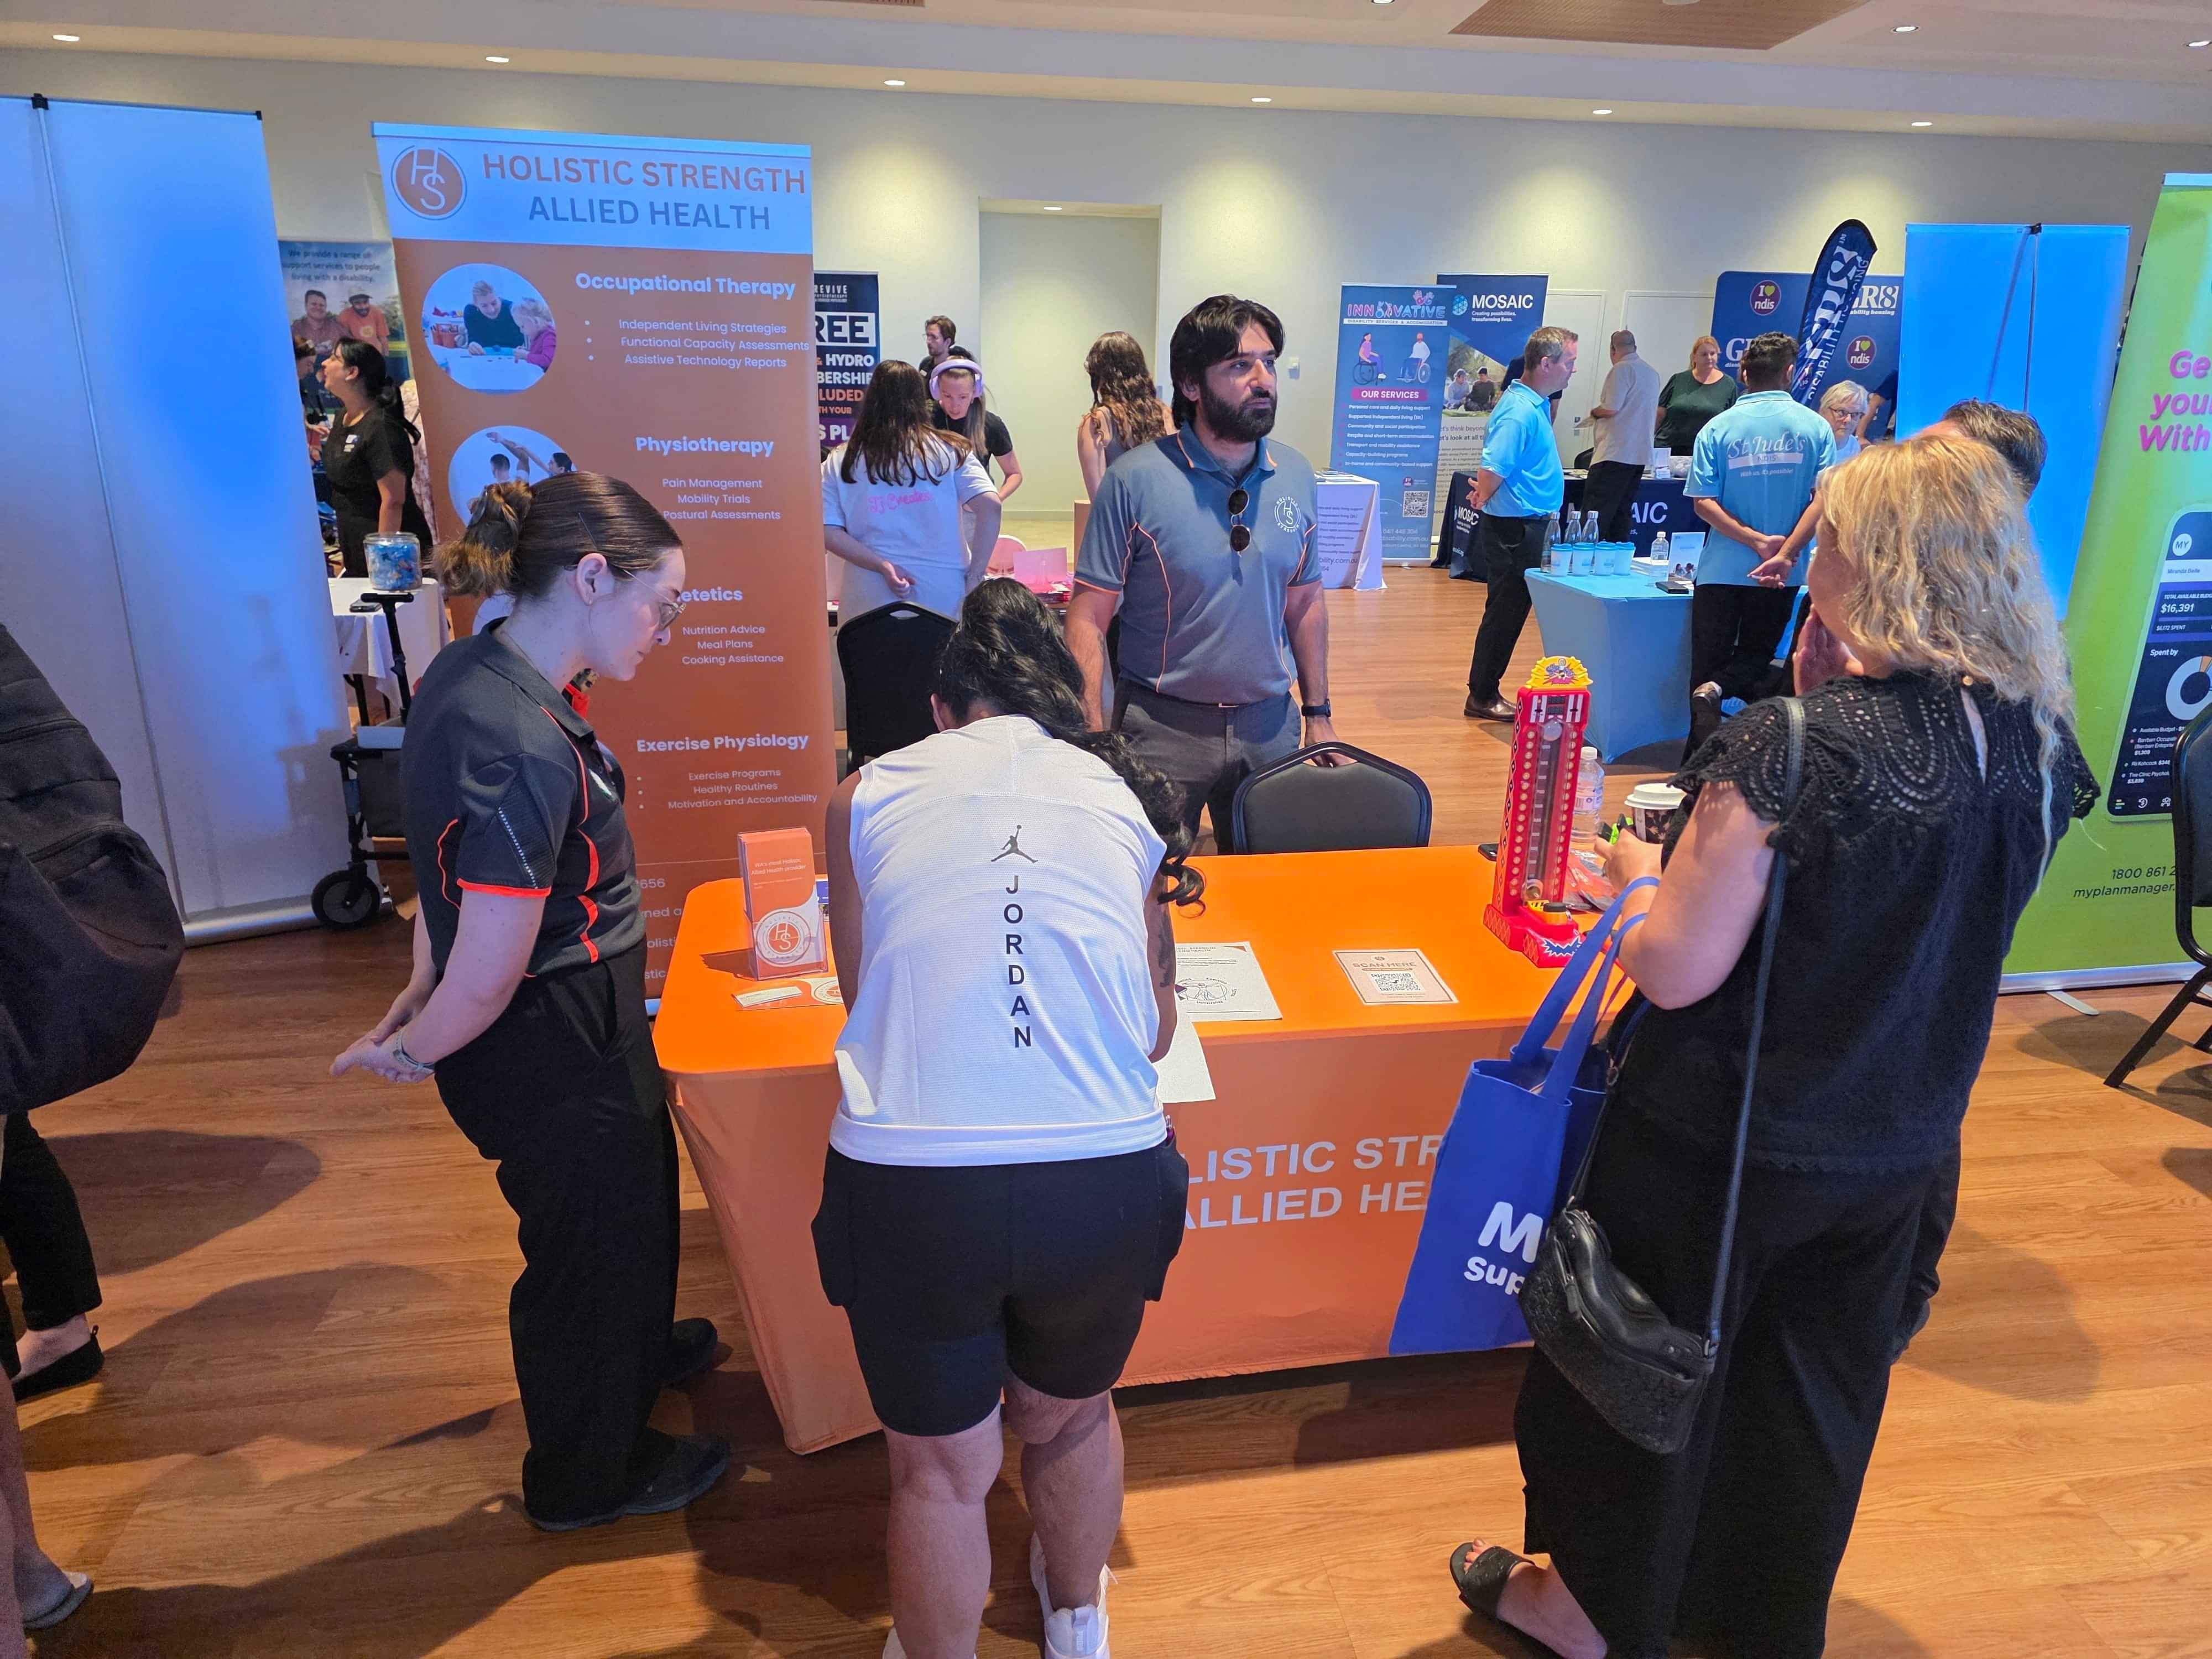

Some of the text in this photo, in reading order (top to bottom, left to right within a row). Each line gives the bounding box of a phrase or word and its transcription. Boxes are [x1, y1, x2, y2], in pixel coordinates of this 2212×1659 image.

[482, 153, 806, 194] HOLISTIC STRENGTH
[528, 195, 770, 230] ALLIED HEALTH
[575, 272, 796, 300] Occupational Therapy
[814, 284, 848, 294] REVIVE
[1472, 294, 1533, 309] MOSAIC
[1754, 299, 1775, 310] ndis
[618, 318, 787, 336] Independent Living Strategies
[815, 315, 869, 343] REE
[620, 336, 810, 352] Functional Capacity Assessments
[624, 354, 787, 369] Assistive Technology Reports
[826, 354, 875, 367] HYDRO
[1850, 353, 1870, 364] ndis
[2169, 350, 2211, 379] Ge
[817, 371, 873, 385] BERSHIP
[819, 389, 864, 401] LUDED
[1361, 390, 1420, 399] OUR SERVICES
[2150, 393, 2212, 420] you
[1749, 431, 1806, 454] Jude's
[2139, 423, 2210, 452] With
[636, 436, 774, 457] Physiotherapy
[662, 478, 763, 491] Pain Management
[677, 493, 750, 505] Mobility Trials
[663, 510, 781, 520] Postural Assessments
[2175, 540, 2190, 550] MY
[677, 587, 743, 602] etetics
[2161, 603, 2195, 614] $16,391
[682, 624, 765, 635] Nutrition Advice
[697, 639, 753, 650] Meal Plans
[682, 654, 784, 666] Cooking Assistance
[2150, 648, 2179, 657] Spent by
[637, 733, 809, 753] Exercise Physiology
[688, 768, 781, 781] Exercise Programs
[693, 781, 779, 796] Healthy Routines
[668, 793, 818, 810] Motivation and Accountability
[2112, 866, 2166, 880] 1800 861
[636, 878, 666, 889] 656
[2074, 884, 2176, 899] myplanmanager.
[1004, 875, 1031, 1048] JORDAN
[1188, 1141, 1337, 1183] LISTIC
